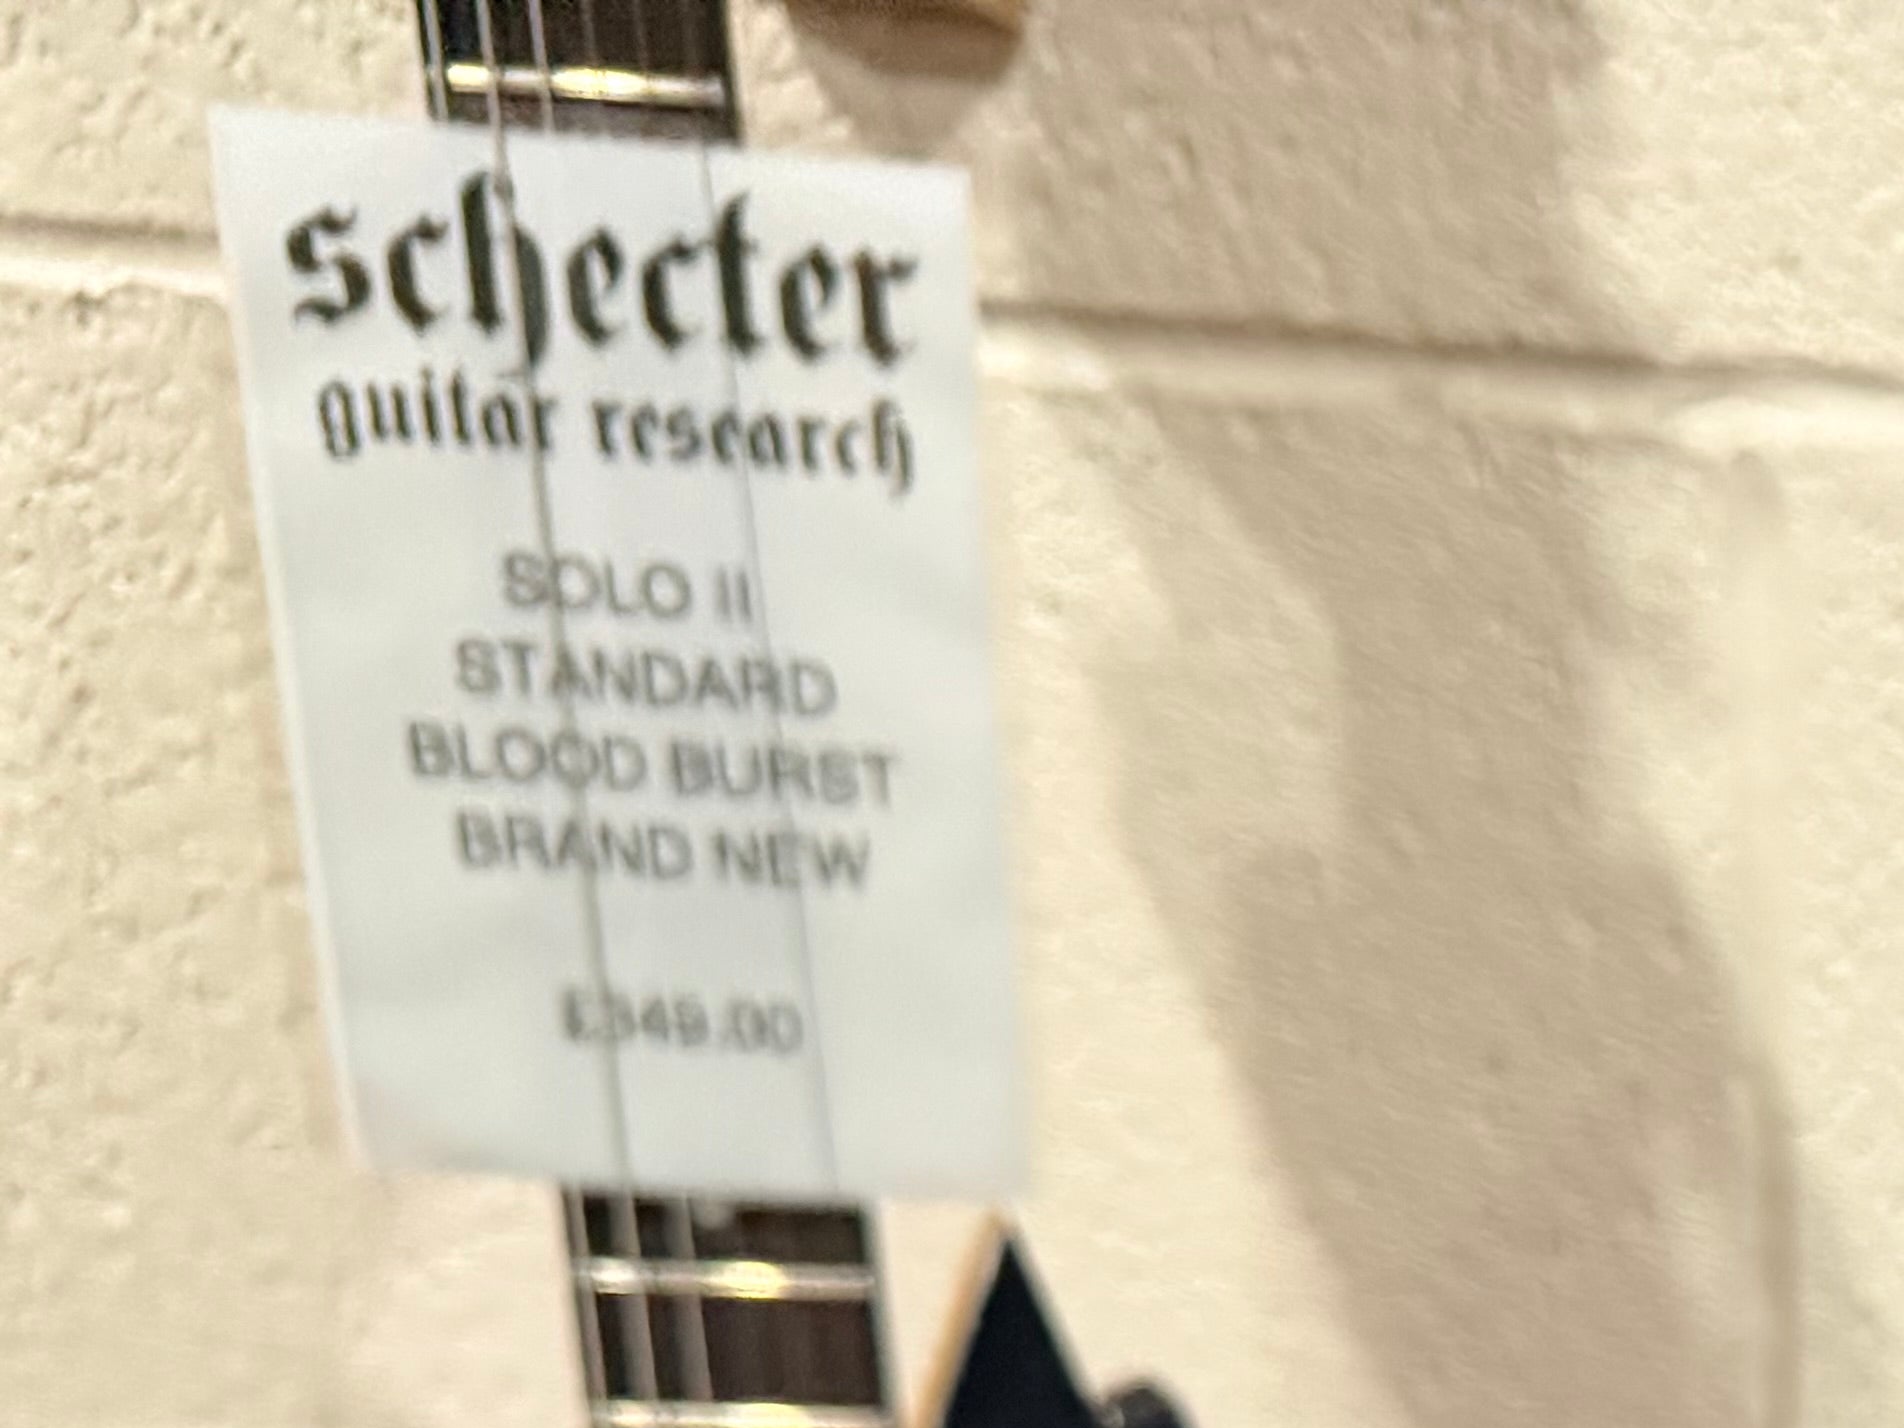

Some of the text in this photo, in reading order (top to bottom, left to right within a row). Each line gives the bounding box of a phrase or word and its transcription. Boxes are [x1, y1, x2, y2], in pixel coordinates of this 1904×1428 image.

[318, 366, 914, 499] guitar research
[500, 552, 692, 621] SOLO
[454, 637, 840, 719] STANDARD
[408, 720, 900, 809] BLOOD BURST
[455, 812, 873, 893] BRAND NEW
